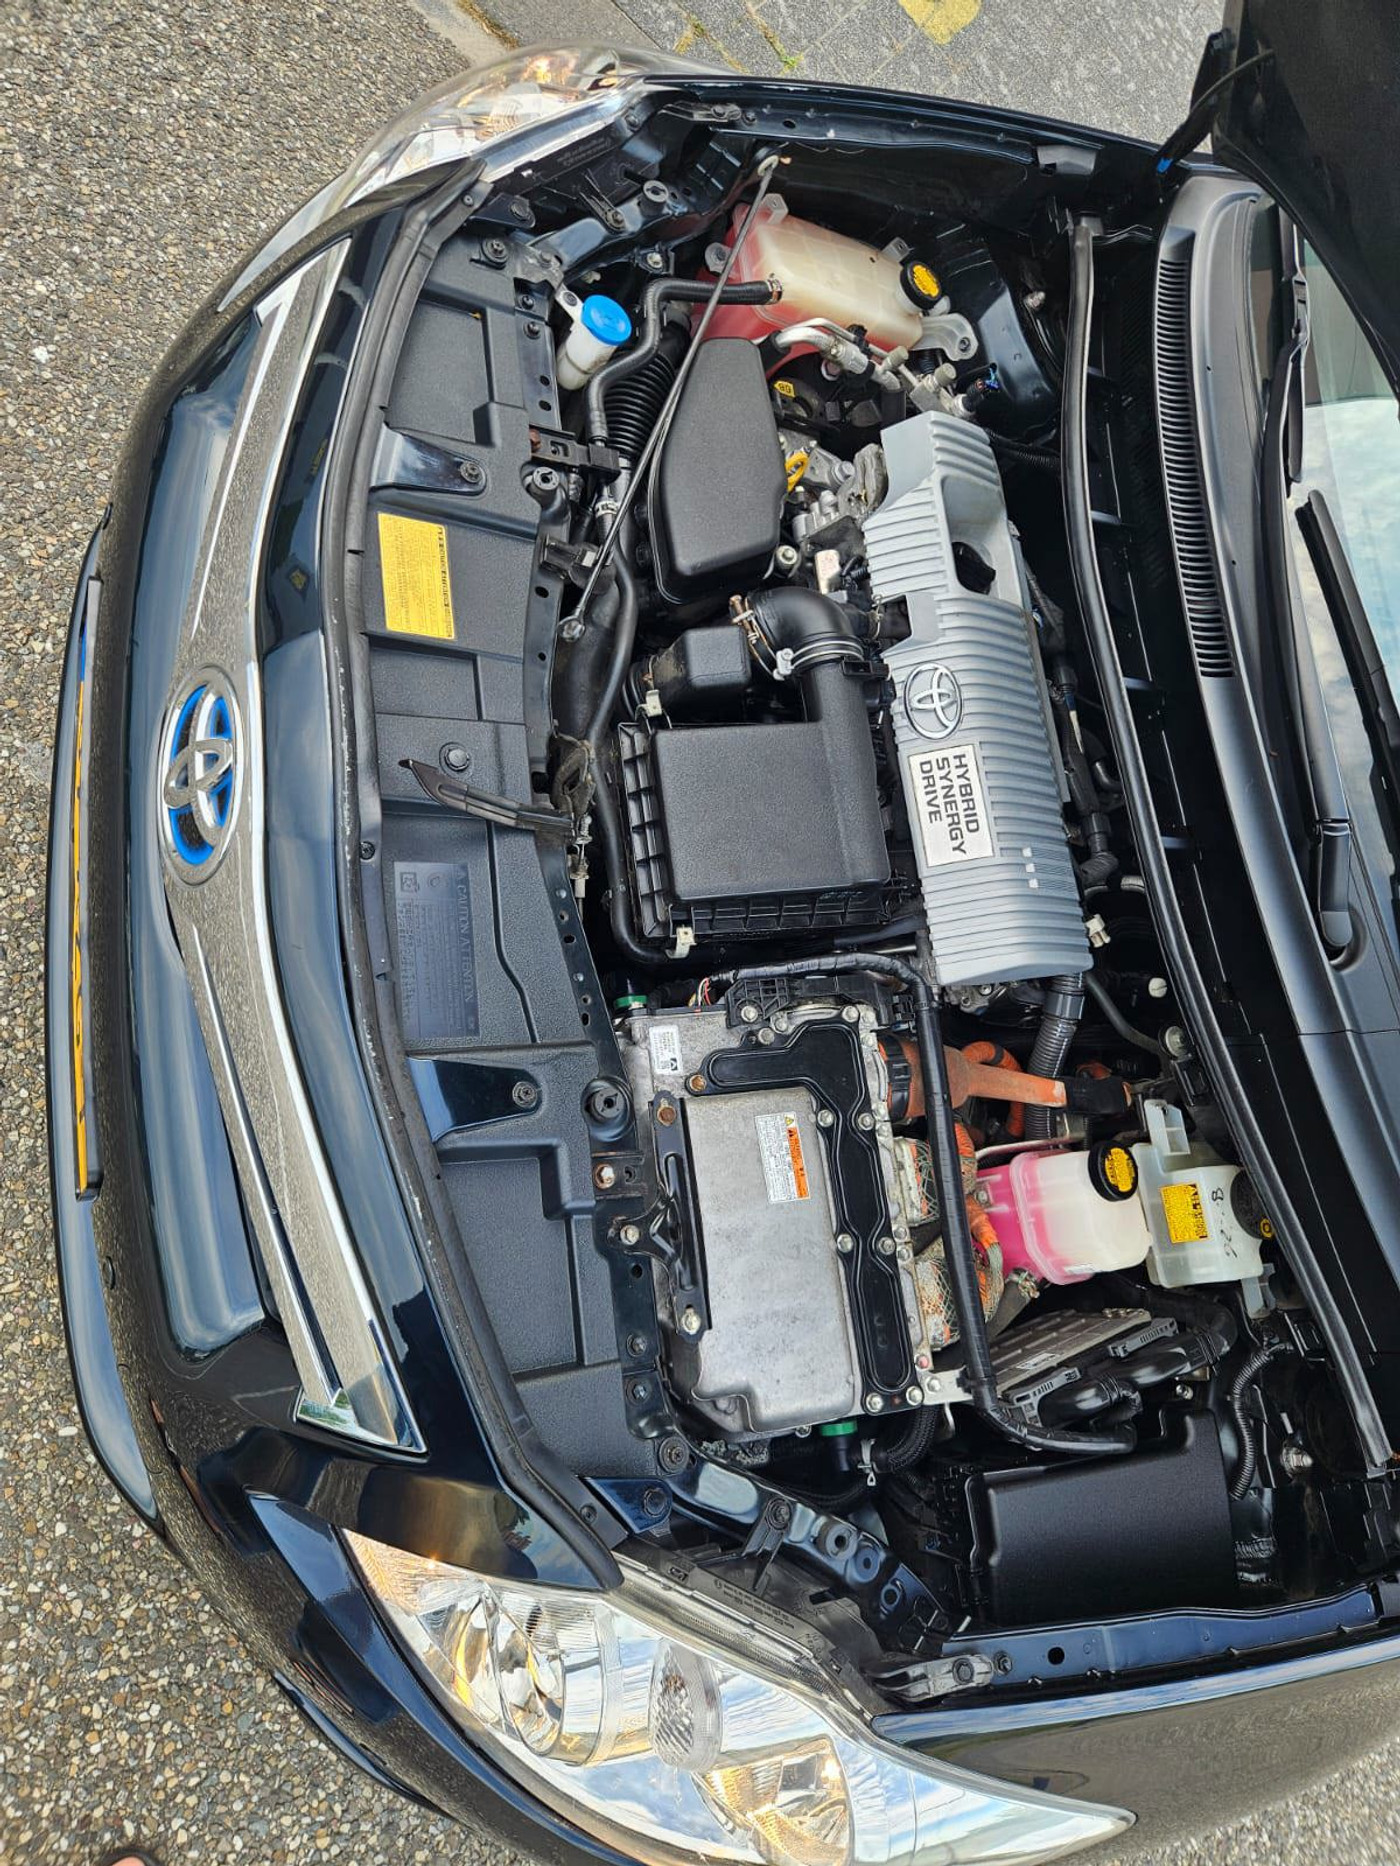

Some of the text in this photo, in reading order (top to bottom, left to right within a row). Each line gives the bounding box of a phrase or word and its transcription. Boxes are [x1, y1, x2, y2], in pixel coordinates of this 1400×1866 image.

[919, 760, 942, 824] DRIVE
[935, 757, 967, 855] SYNERGY
[953, 753, 980, 834] HYBRID
